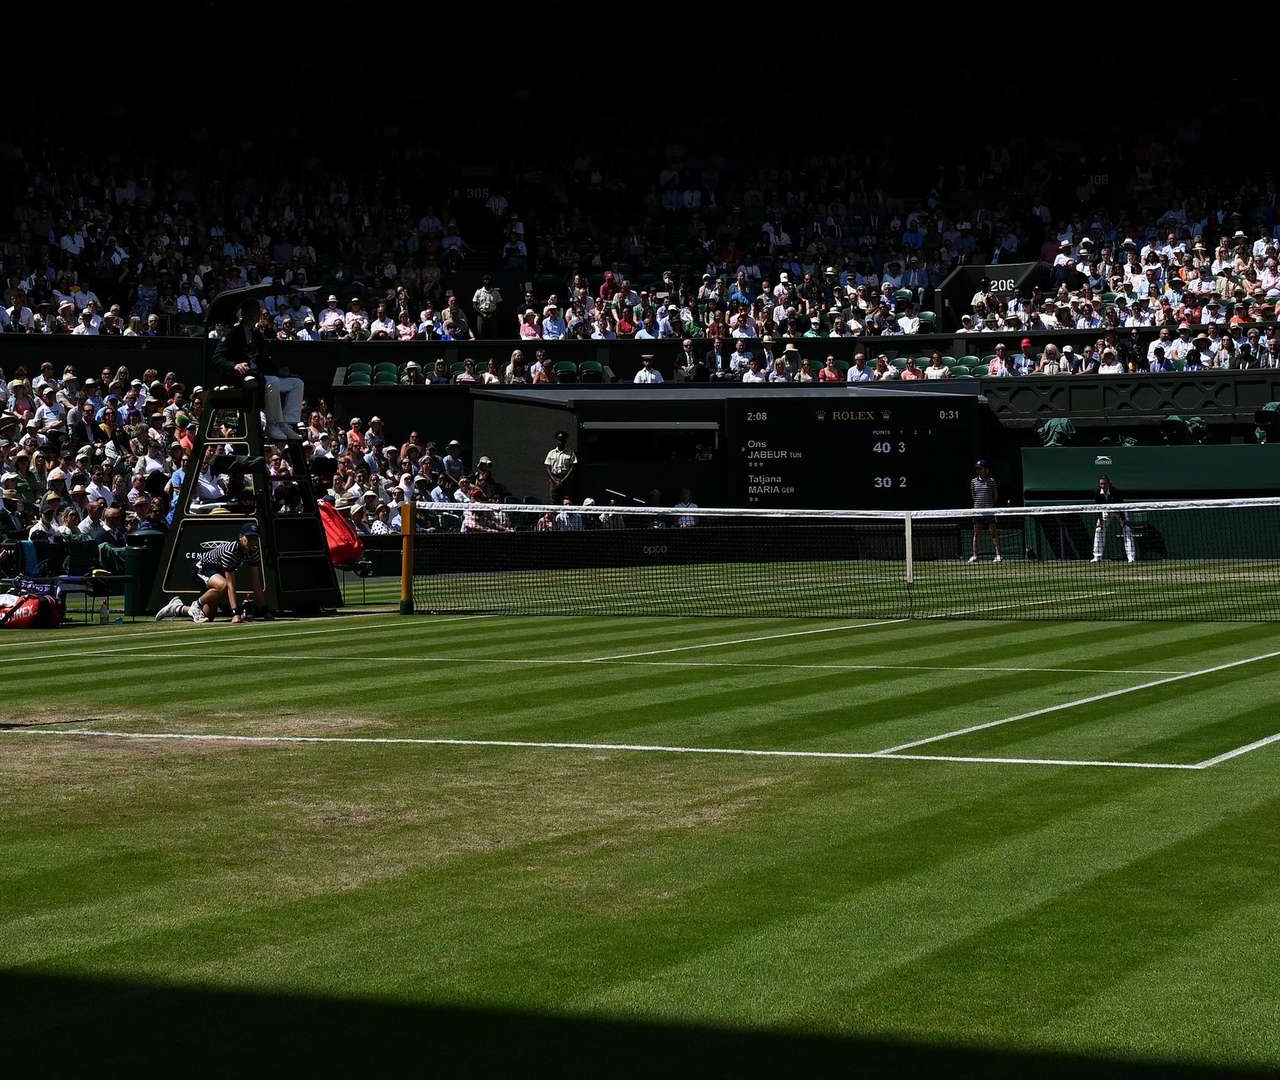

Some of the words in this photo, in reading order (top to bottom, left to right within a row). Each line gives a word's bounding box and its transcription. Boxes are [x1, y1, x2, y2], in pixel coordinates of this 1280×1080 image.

[990, 279, 1015, 292] 206
[746, 412, 767, 421] 2:08
[832, 411, 875, 421] ROLEX
[939, 410, 959, 420] 0:31
[747, 439, 767, 448] Ons
[872, 442, 892, 453] 40
[898, 442, 906, 453] 3
[747, 450, 788, 459] JABEUR
[748, 474, 782, 485] Tatjana
[874, 477, 892, 488] 30
[899, 477, 907, 487] 2
[748, 485, 780, 494] MARIA
